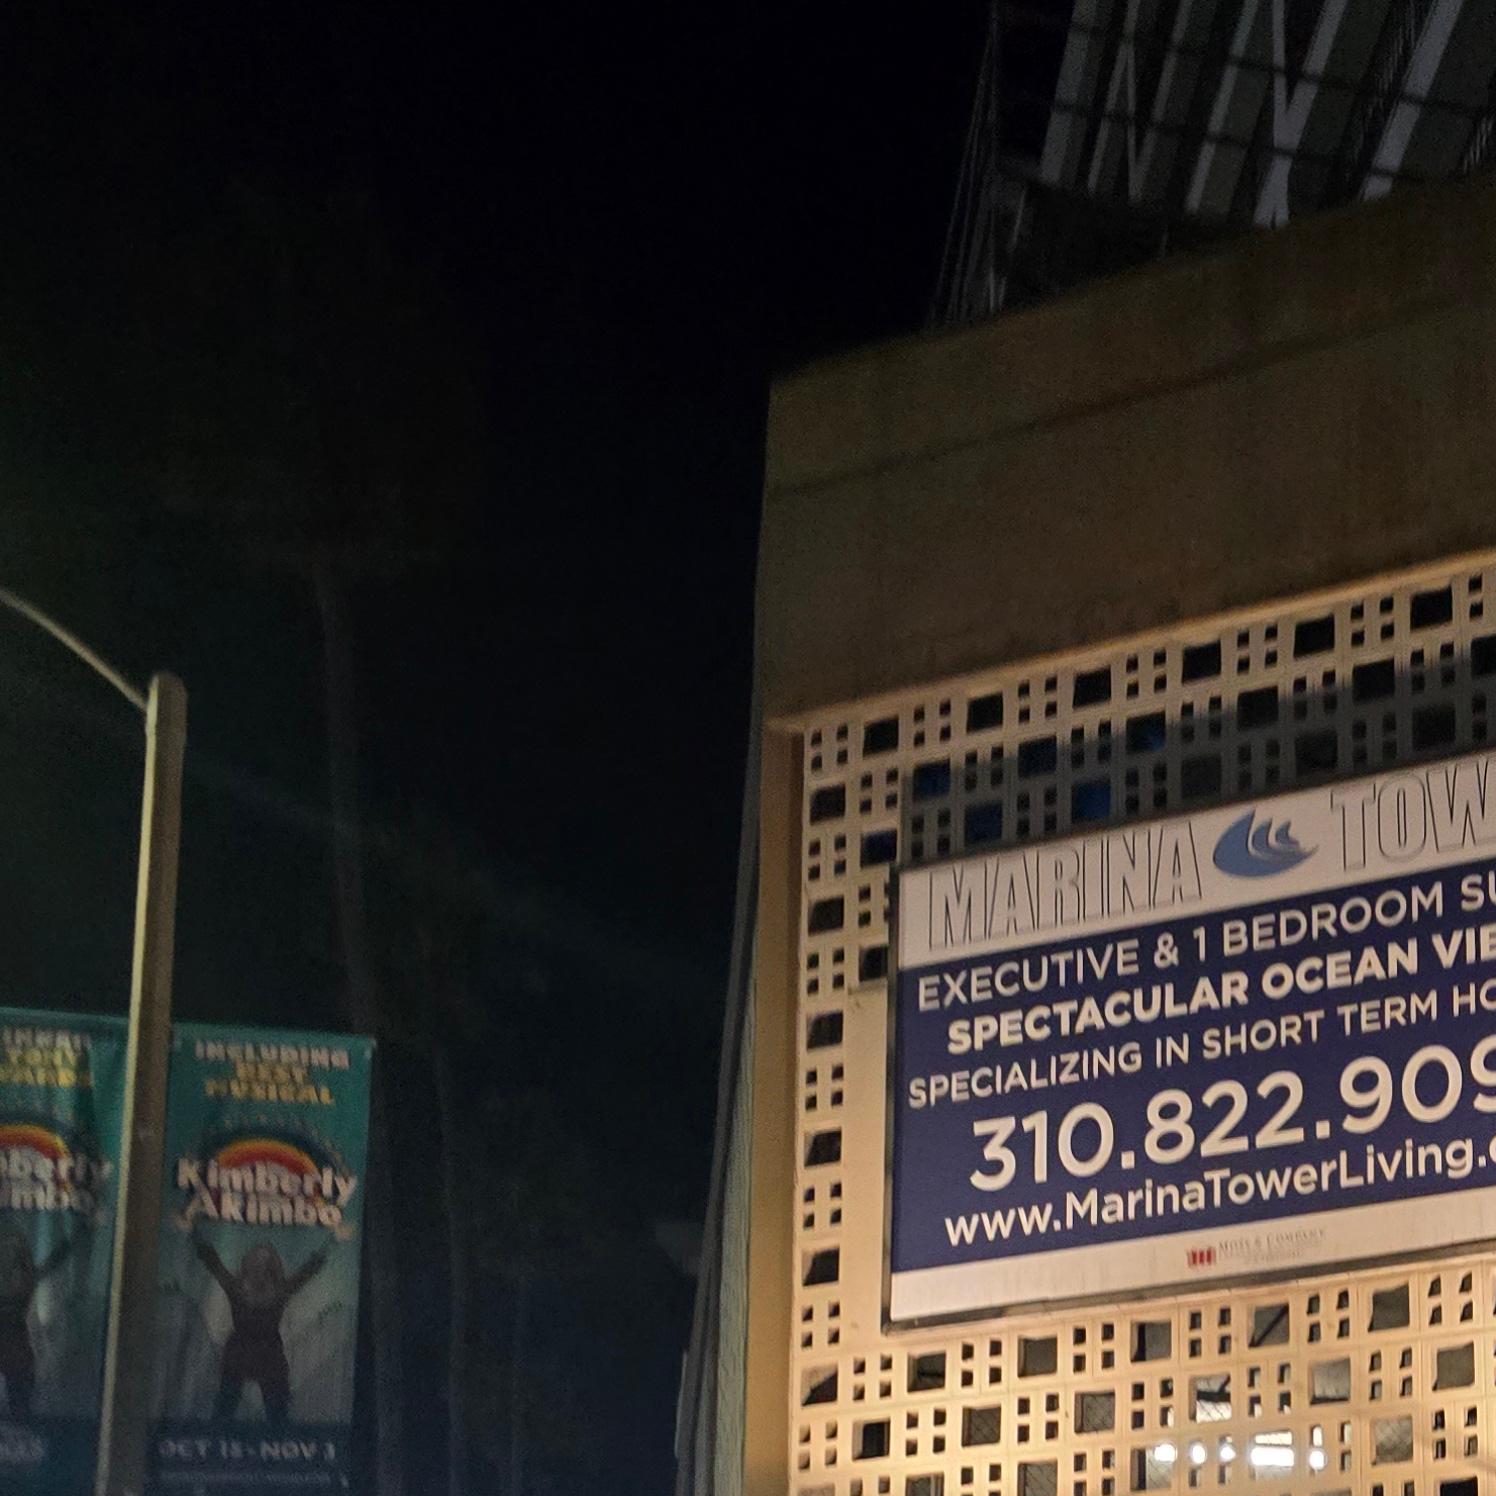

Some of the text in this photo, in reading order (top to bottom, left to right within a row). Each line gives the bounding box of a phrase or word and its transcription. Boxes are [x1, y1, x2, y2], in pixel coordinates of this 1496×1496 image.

[928, 820, 1203, 952] MARINA
[918, 938, 1140, 1013] EXECUTIVE
[1153, 932, 1180, 969] &
[1193, 925, 1206, 963] 1
[1223, 881, 1443, 959] BEDROOM
[946, 970, 1250, 1056] SPECTACULAR
[1261, 937, 1419, 1001] OCEAN
[908, 1040, 1143, 1109] SPECIALIZING
[1155, 1032, 1190, 1069] IN
[1202, 1009, 1326, 1060] SHORT
[1336, 988, 1439, 1037] TERM
[177, 1157, 359, 1208] Kimberly
